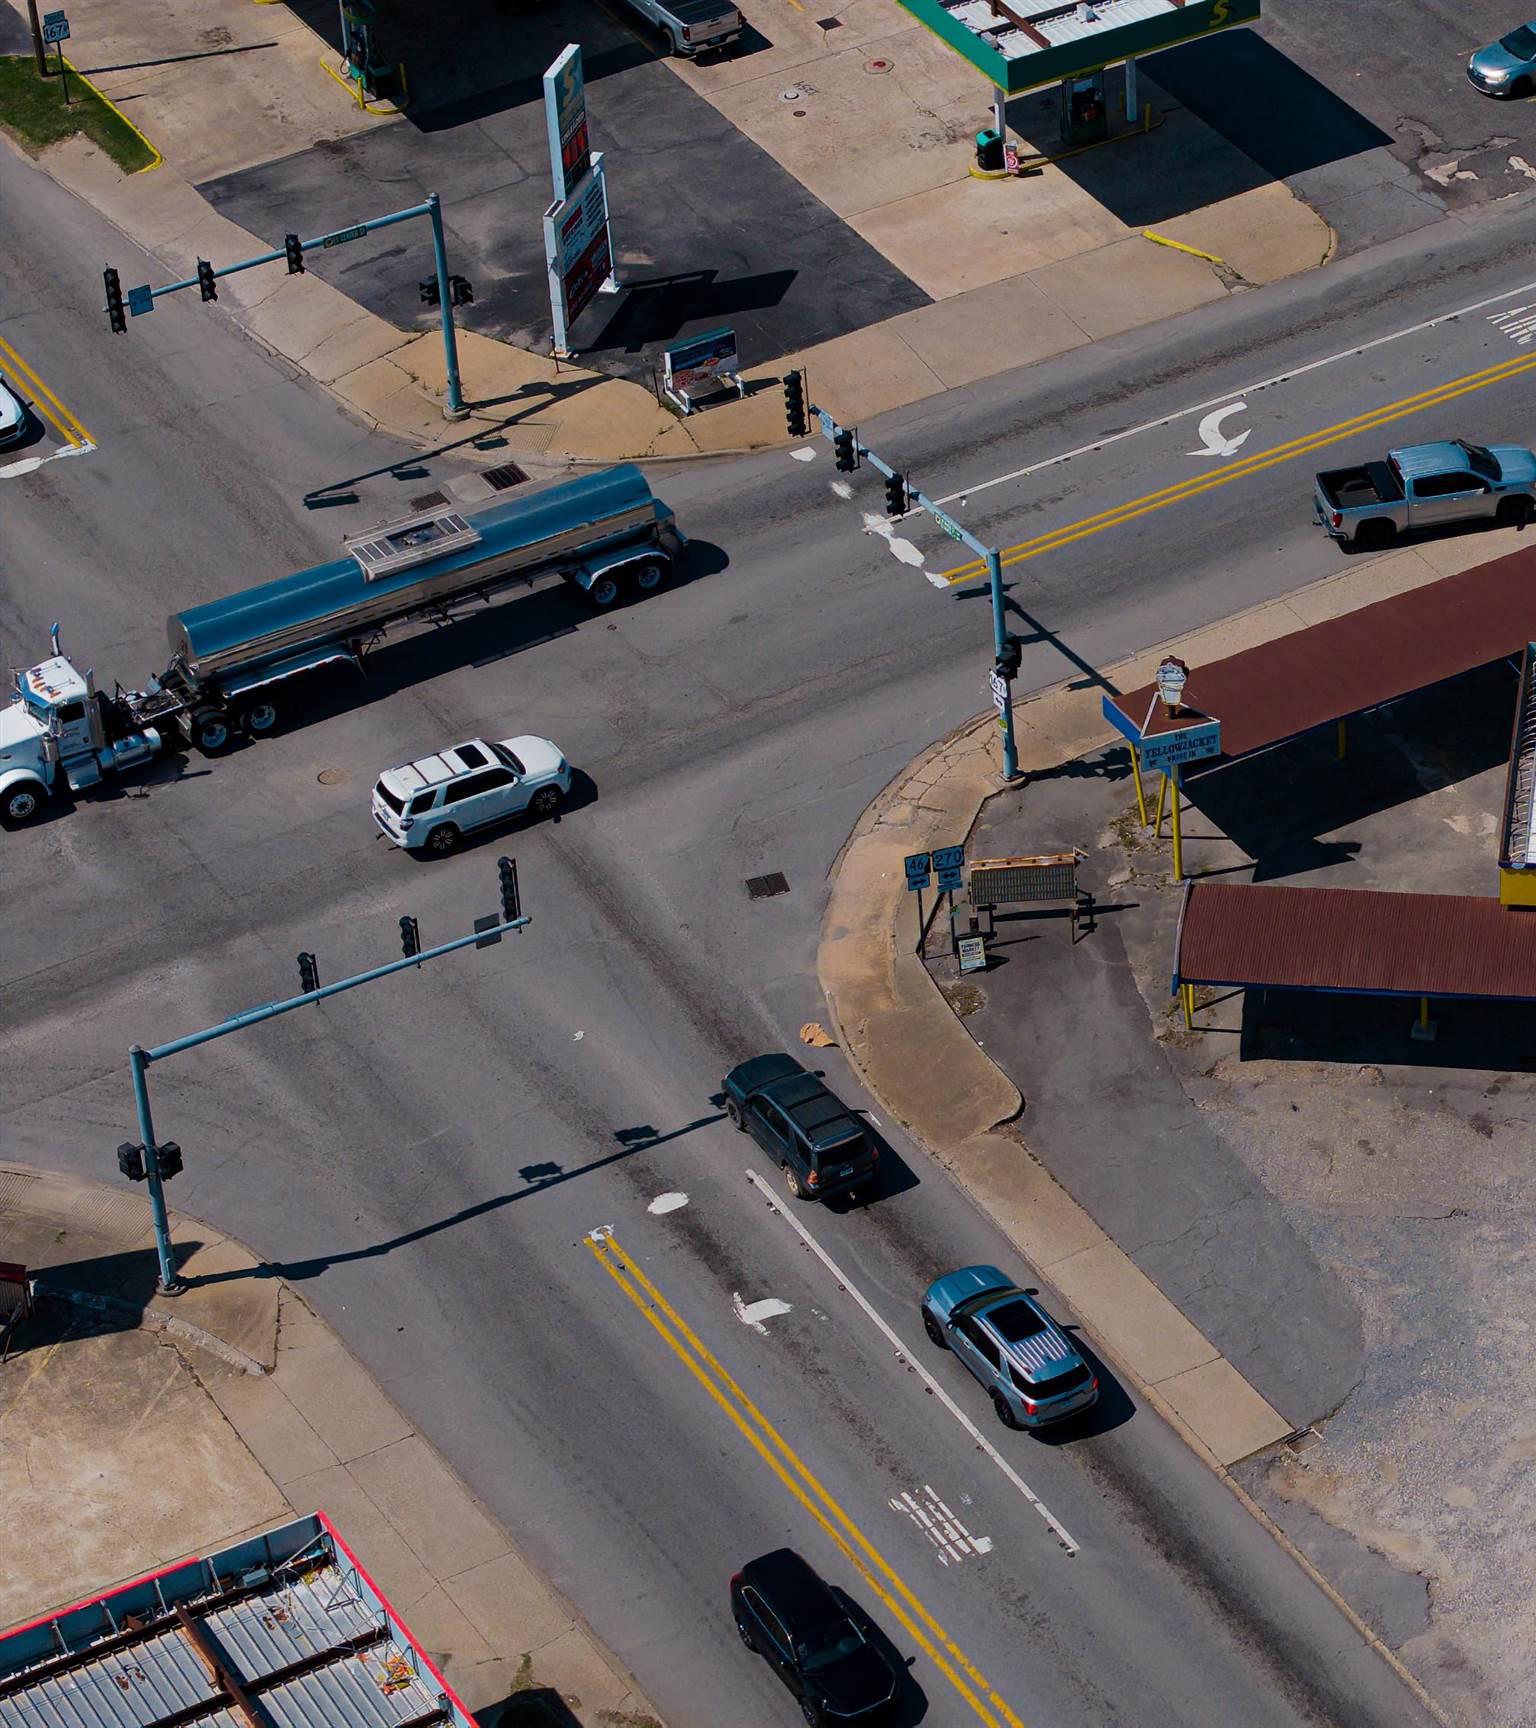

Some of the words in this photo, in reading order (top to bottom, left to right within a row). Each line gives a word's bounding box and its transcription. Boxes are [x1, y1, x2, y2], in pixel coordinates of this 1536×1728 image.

[1145, 734, 1217, 759] YELLOWJACKET
[910, 858, 924, 871] 46
[936, 850, 961, 867] 270
